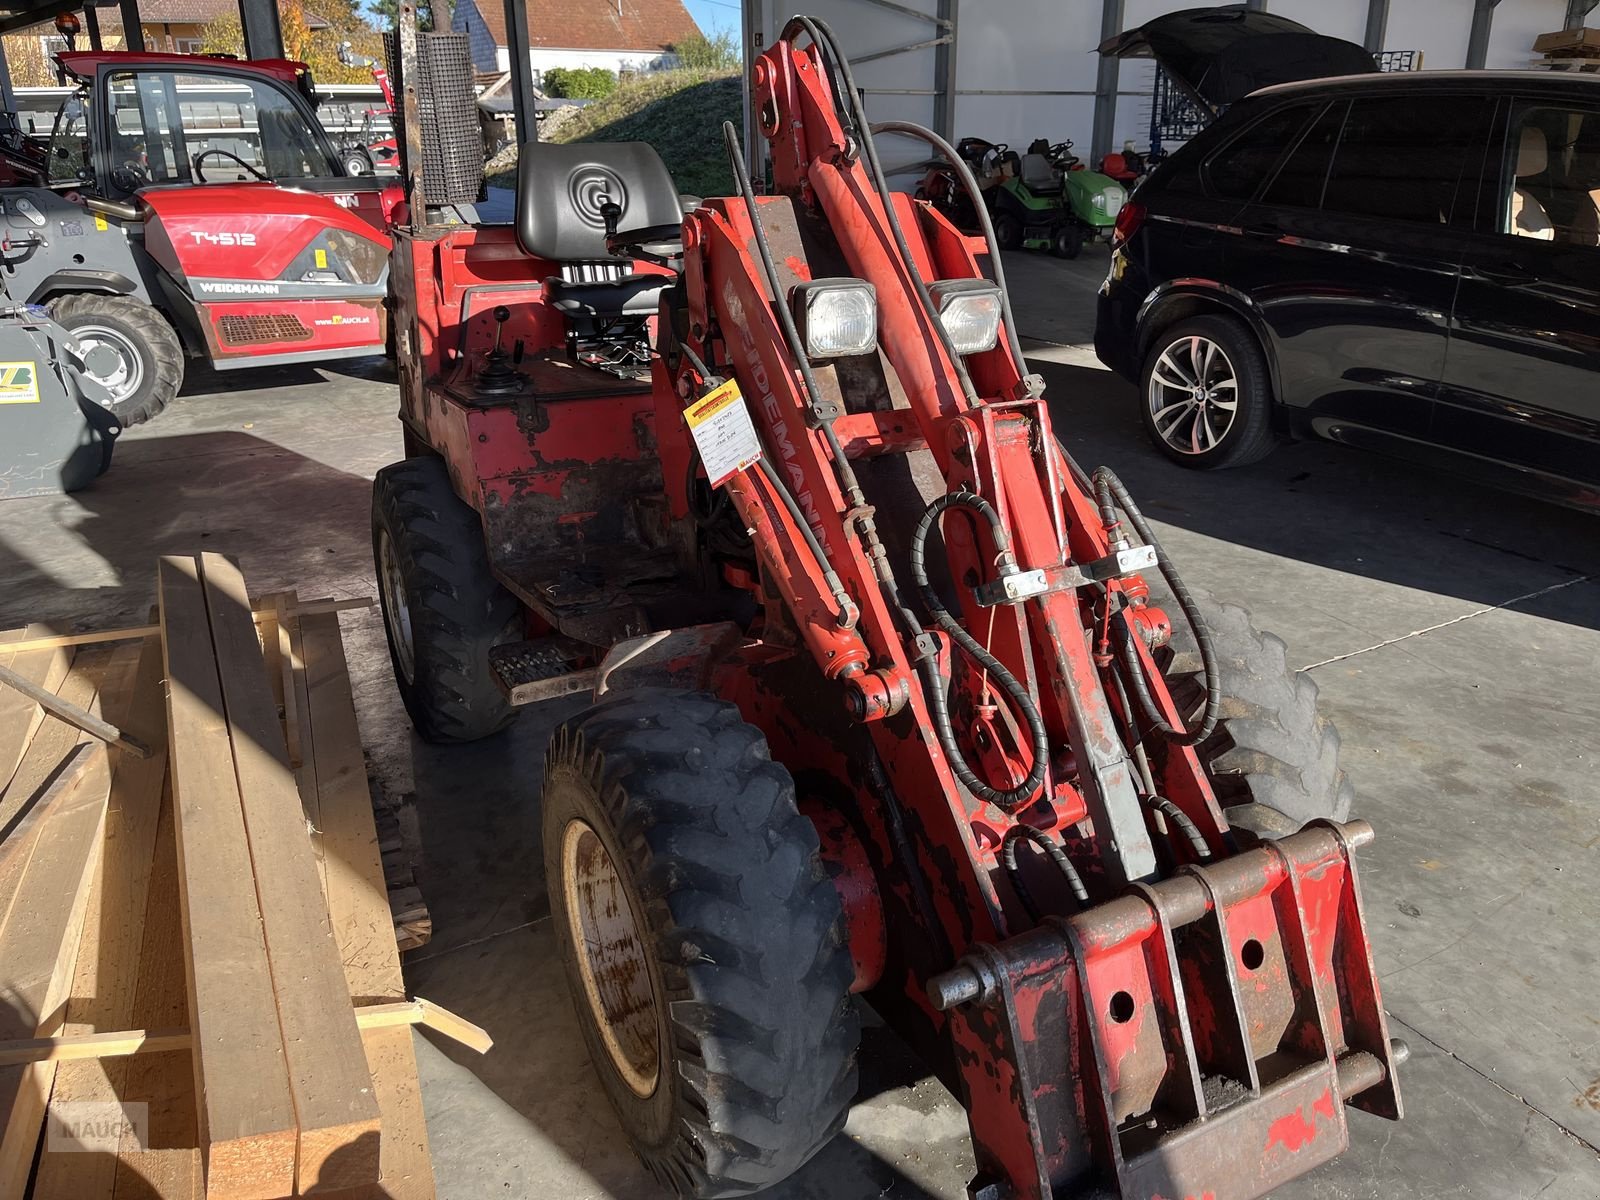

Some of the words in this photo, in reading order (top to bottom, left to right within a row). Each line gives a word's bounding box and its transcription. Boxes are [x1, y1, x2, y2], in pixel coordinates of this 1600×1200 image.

[190, 231, 256, 246] T4512
[200, 283, 279, 294] WEIDEMANN
[739, 453, 760, 468] MAUCH
